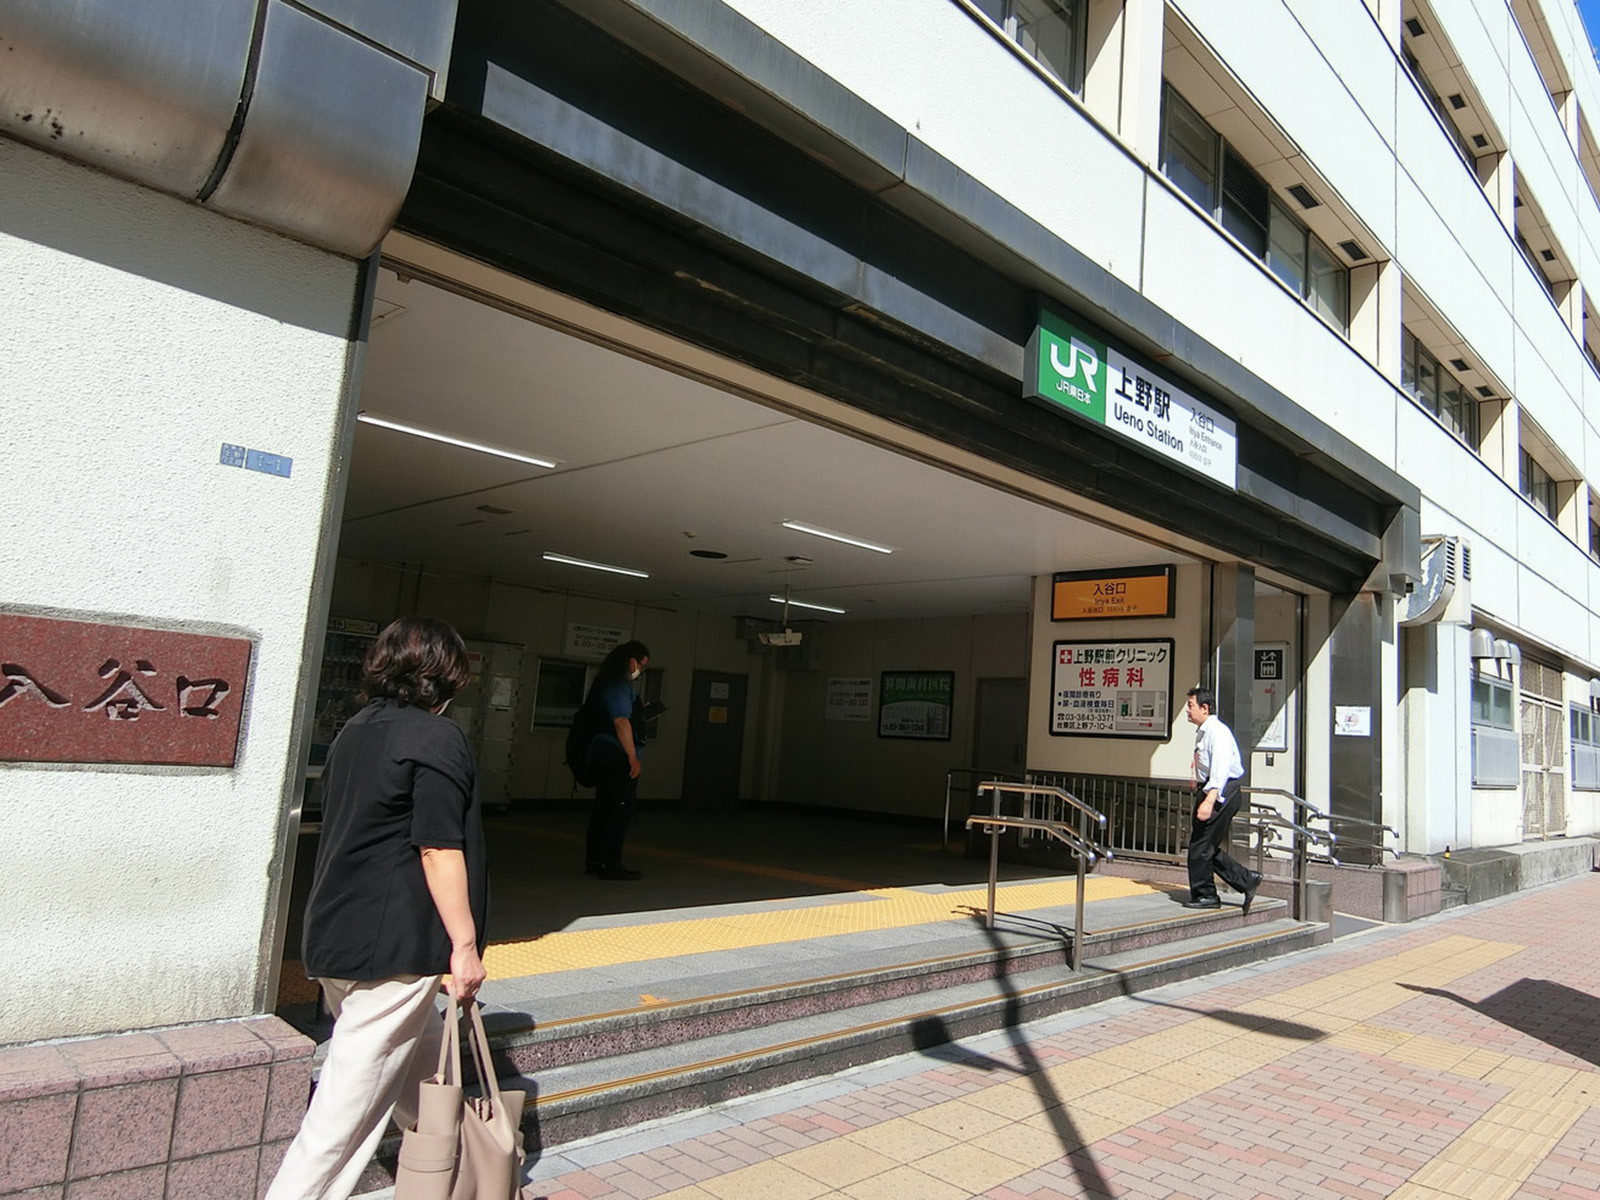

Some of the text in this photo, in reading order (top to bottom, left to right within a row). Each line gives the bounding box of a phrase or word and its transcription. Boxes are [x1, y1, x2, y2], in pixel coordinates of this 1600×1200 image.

[1050, 336, 1099, 394] JR
[1055, 380, 1092, 405] JR東日本
[1114, 366, 1172, 422] 上野駅
[1113, 402, 1184, 453] Ueno Station
[1190, 407, 1215, 434] 入谷口
[1200, 431, 1223, 451] Entrance
[1092, 582, 1127, 596] 入谷口
[1111, 596, 1125, 605] Exit
[1073, 647, 1168, 665] 上野駅前クリニック
[1078, 666, 1145, 688] 性病科
[0, 656, 231, 722] 入谷口
[1056, 721, 1114, 730] 台東区上野7-10-4
[1065, 712, 1115, 722] 03-3843-3371
